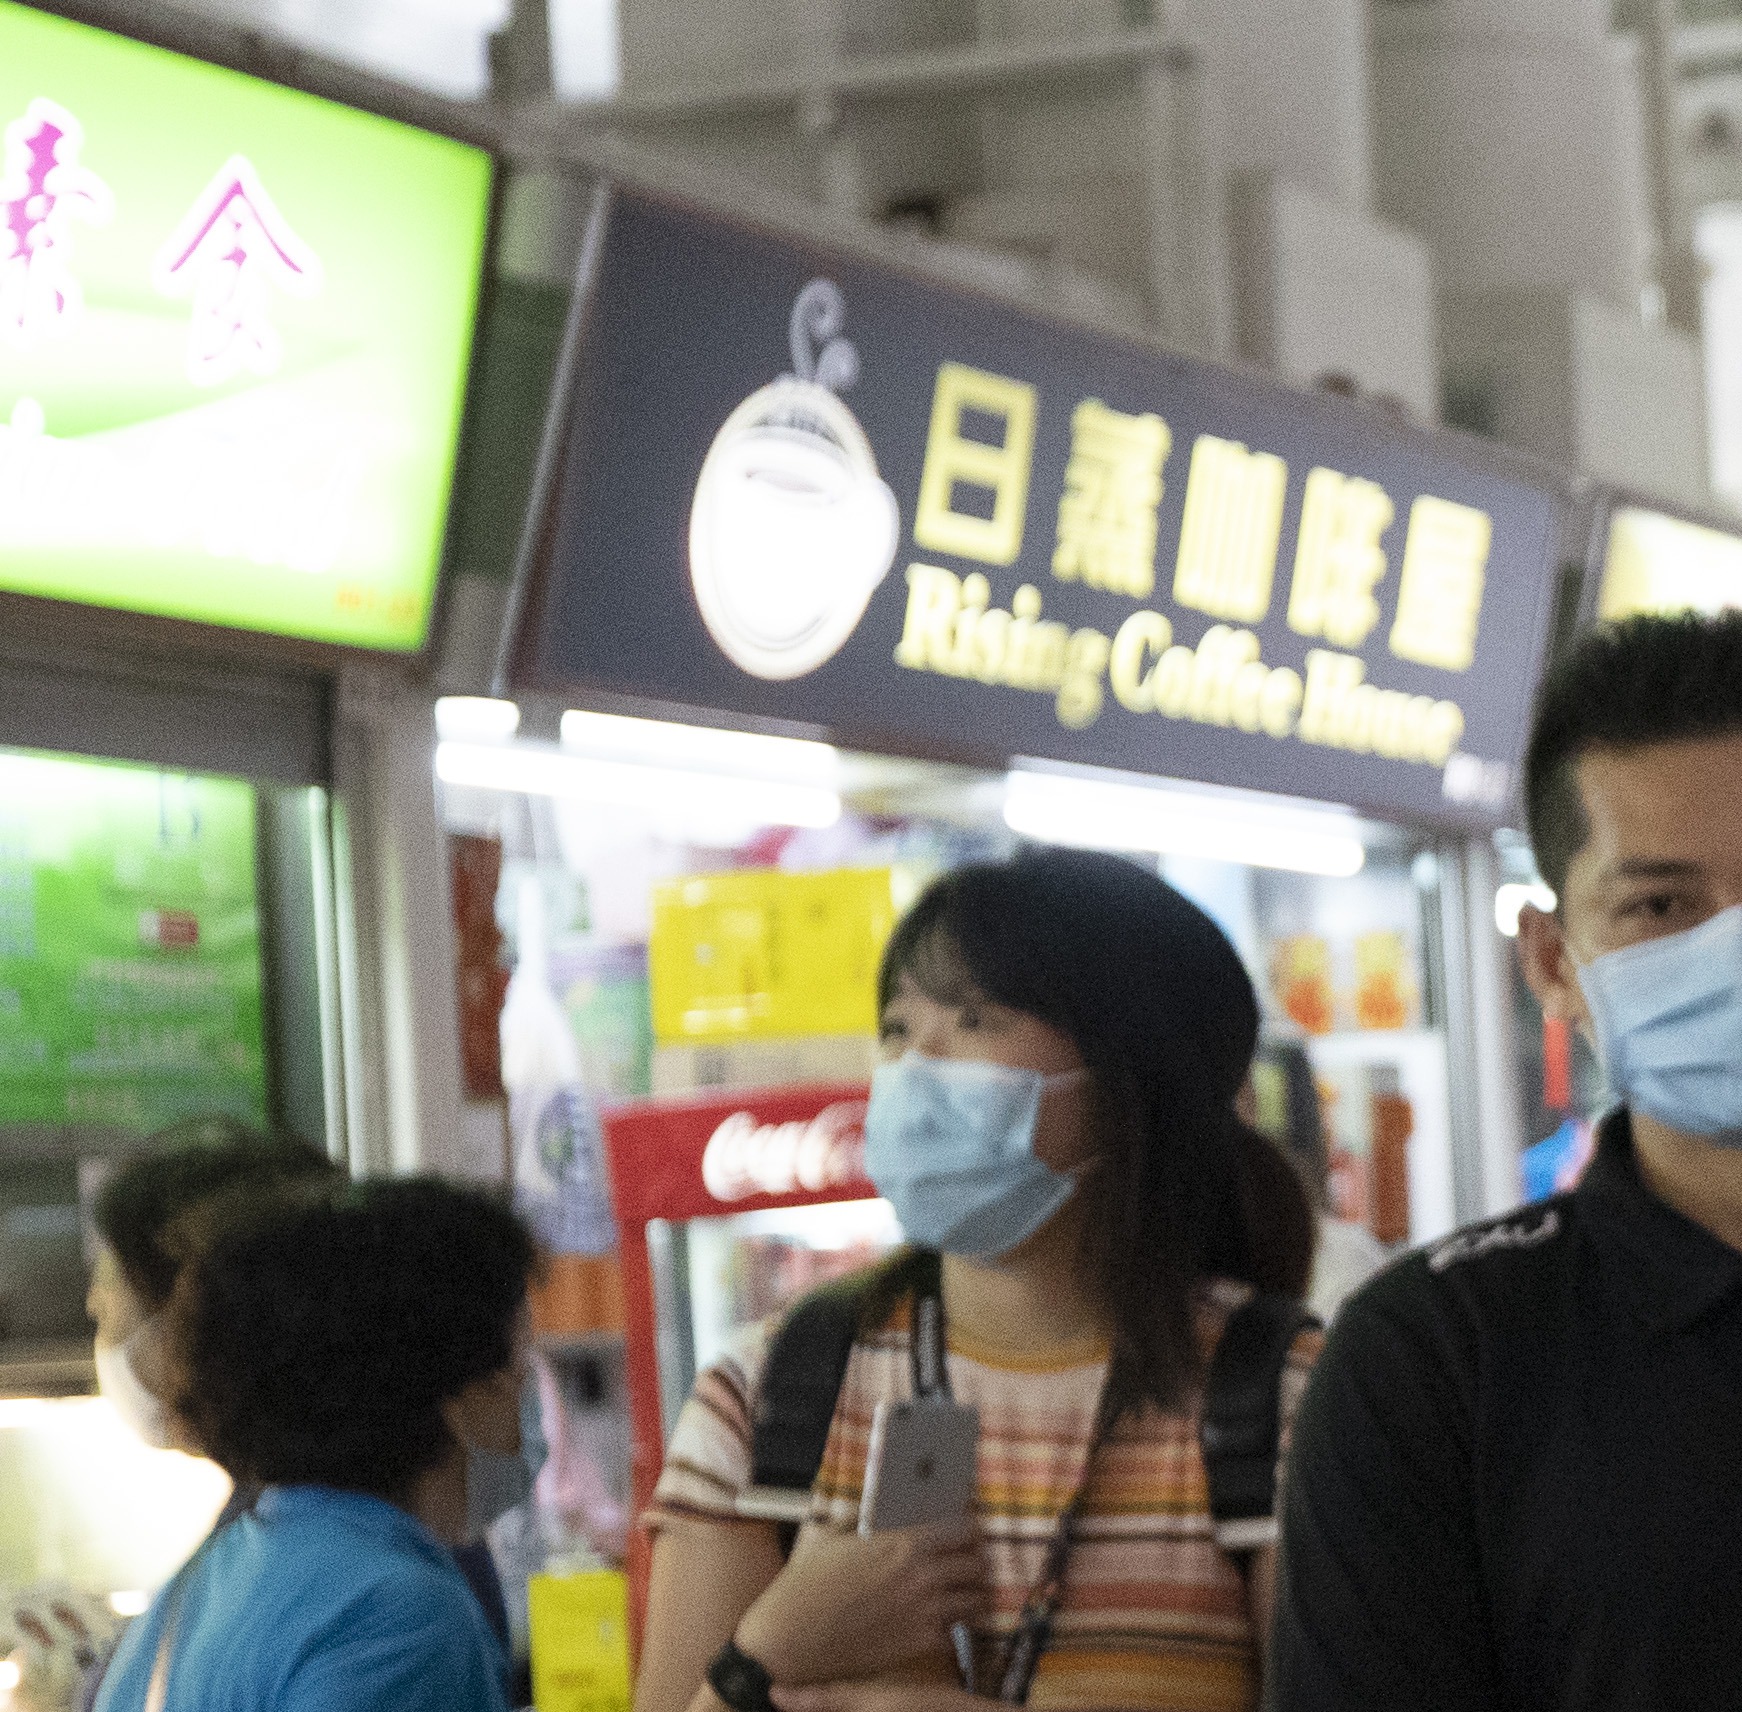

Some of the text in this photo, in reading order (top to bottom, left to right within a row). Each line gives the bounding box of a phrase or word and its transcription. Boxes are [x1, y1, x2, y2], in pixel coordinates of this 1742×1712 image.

[894, 562, 1465, 768] Rising Coffee House
